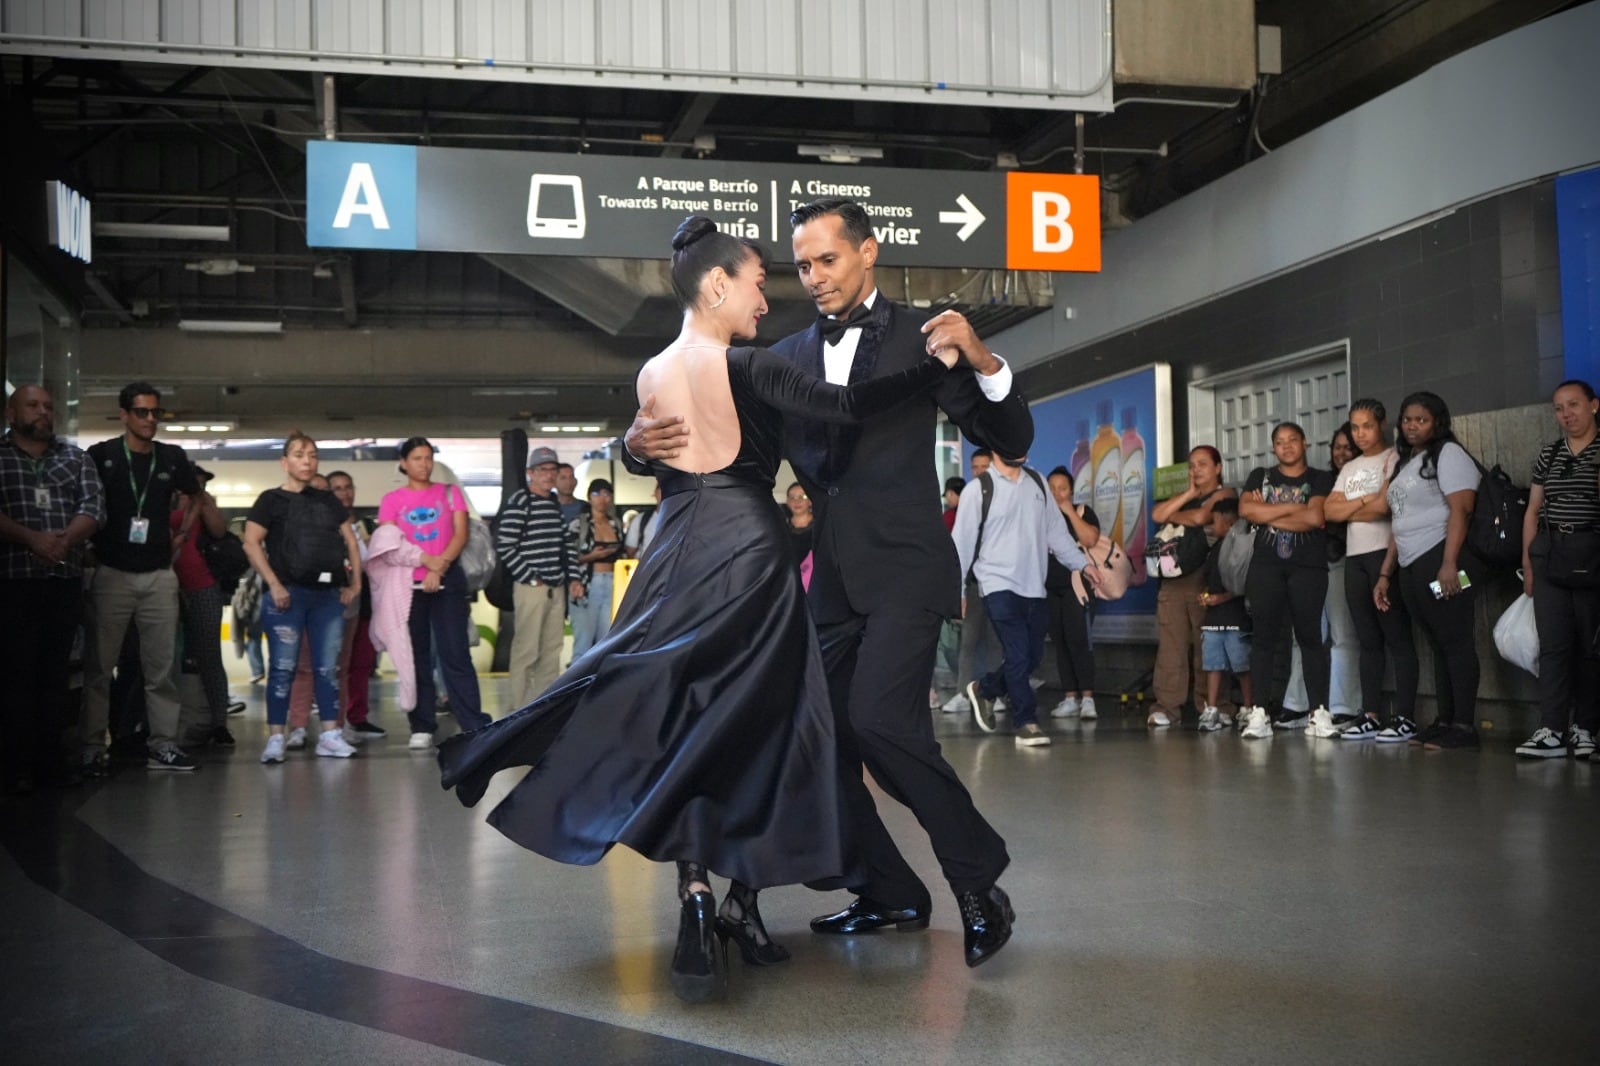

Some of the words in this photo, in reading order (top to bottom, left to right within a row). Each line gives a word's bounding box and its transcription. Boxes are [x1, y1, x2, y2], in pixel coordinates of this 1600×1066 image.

[637, 176, 649, 190] A
[652, 177, 704, 194] Parque
[708, 178, 759, 193] Berrío
[790, 179, 802, 194] A
[806, 180, 871, 197] Cisneros
[332, 162, 391, 230] A
[598, 195, 658, 209] Towards
[661, 196, 709, 212] Parque
[713, 198, 759, 212] Berrío
[856, 201, 913, 218] isneros
[1031, 190, 1075, 253] B
